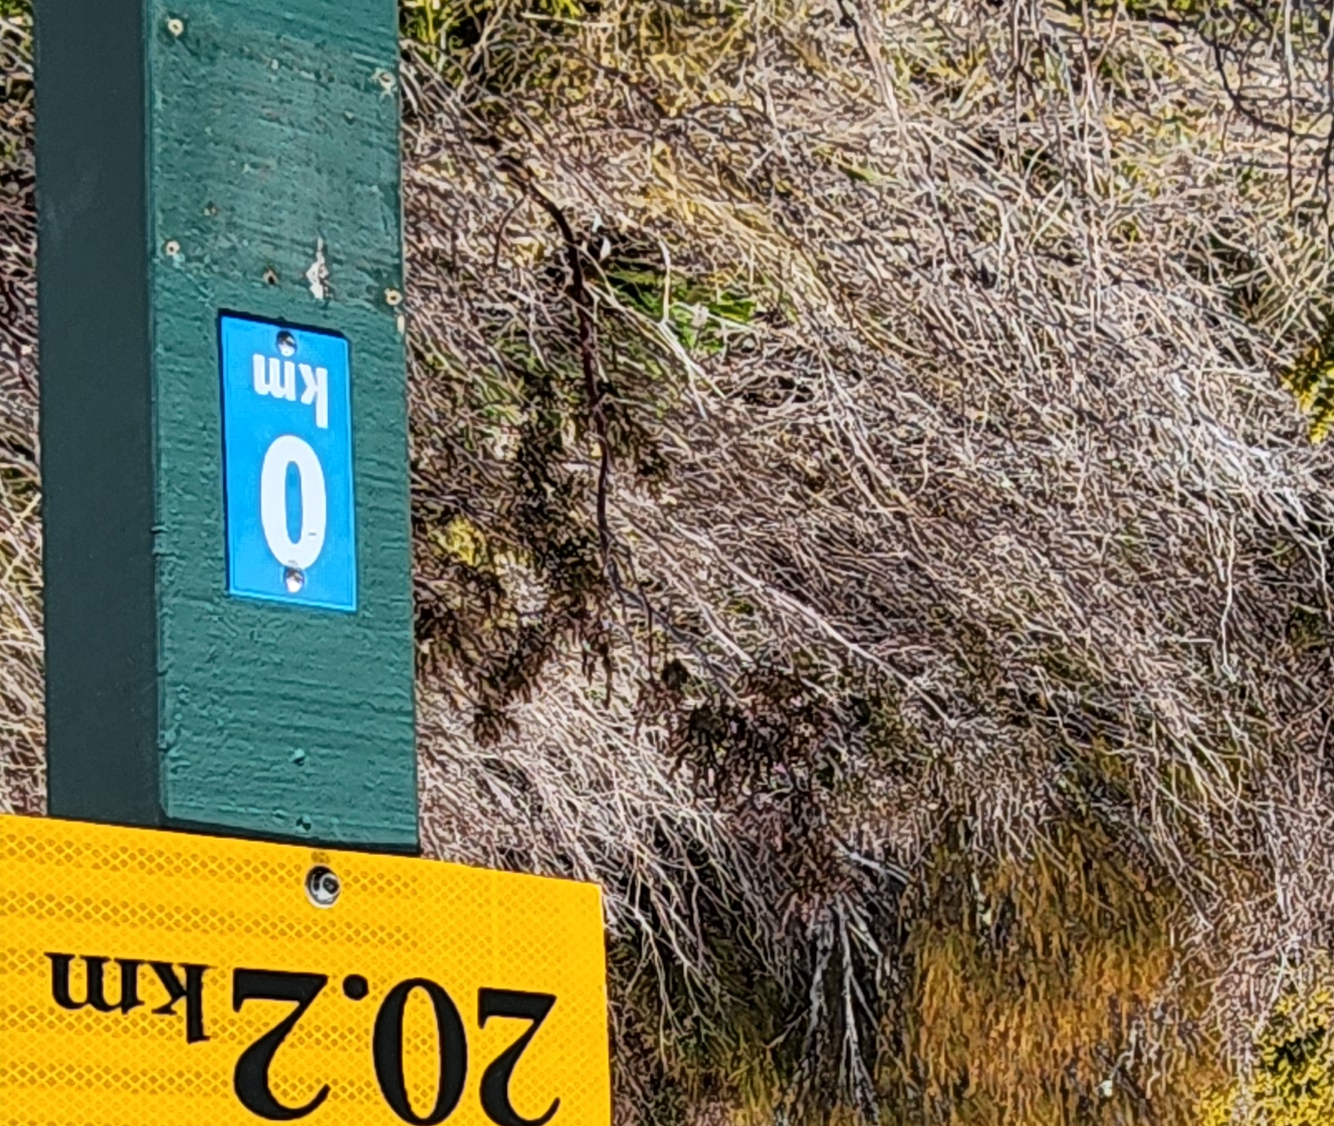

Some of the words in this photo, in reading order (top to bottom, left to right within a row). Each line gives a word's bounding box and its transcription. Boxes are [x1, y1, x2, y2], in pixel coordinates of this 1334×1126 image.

[252, 353, 328, 428] km
[260, 434, 327, 571] 0
[44, 952, 210, 1044] km
